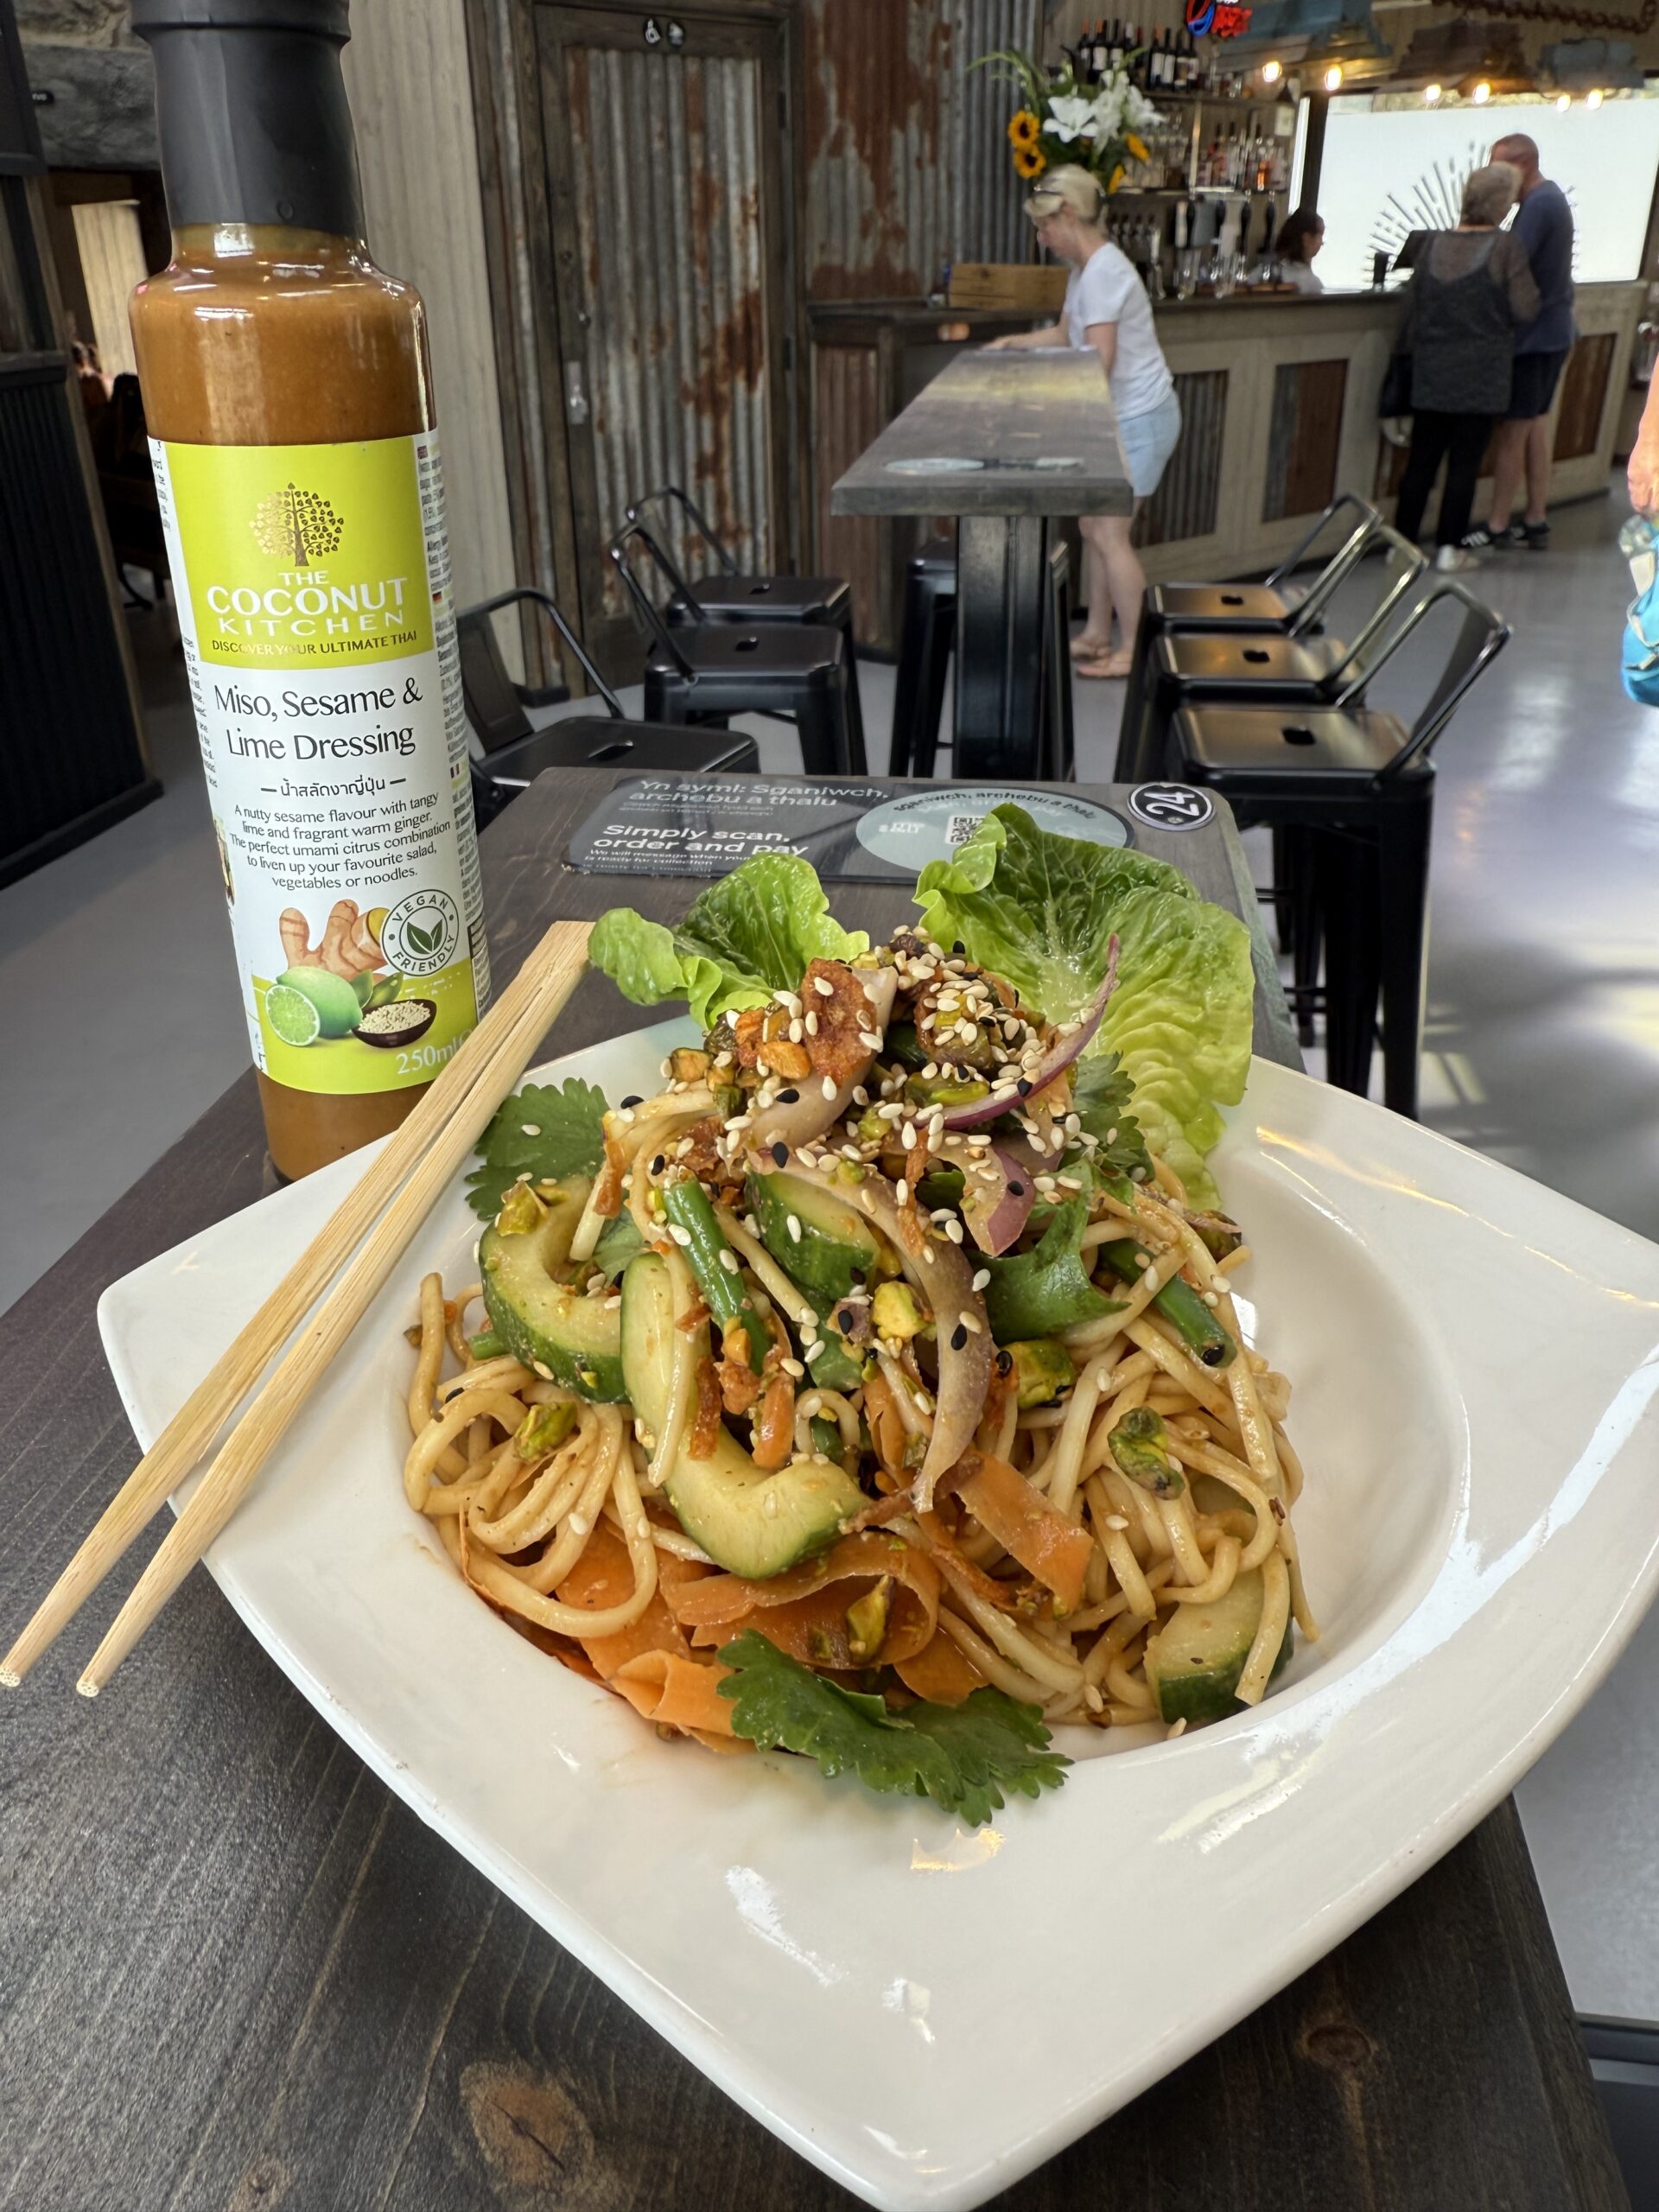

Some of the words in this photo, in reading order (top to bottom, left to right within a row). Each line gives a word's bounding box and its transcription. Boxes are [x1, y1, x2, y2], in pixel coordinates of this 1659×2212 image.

[279, 570, 329, 586] THE
[207, 577, 408, 616] COCONUT
[219, 610, 403, 637] KITCHEN
[320, 636, 389, 654] ULTIMATE
[391, 630, 417, 645] THAI
[214, 684, 278, 722] Miso,
[282, 687, 397, 717] Sesame
[402, 677, 423, 705] &
[226, 728, 286, 760] Lime
[293, 724, 416, 760] Dressing
[234, 804, 243, 817] A
[244, 808, 271, 823] nutty
[274, 811, 325, 823] sesame
[328, 808, 377, 822] flavour
[379, 799, 407, 816] with
[410, 791, 439, 810] tangy
[629, 790, 741, 804] archebu
[769, 794, 838, 806] thalu
[1142, 790, 1201, 817] 24
[229, 832, 247, 849] The
[248, 841, 290, 855] perfect
[292, 842, 340, 856] umami
[342, 841, 380, 855] citrus
[384, 821, 451, 849] combination
[242, 820, 265, 836] lime
[267, 826, 290, 839] and
[292, 827, 350, 842] fragrant
[352, 822, 391, 836] warm
[394, 811, 432, 833] ginger.
[602, 824, 709, 841] Simply
[711, 830, 791, 842] scan,
[247, 855, 257, 867] to
[259, 855, 286, 871] liven
[289, 863, 305, 875] up
[308, 862, 340, 876] your
[344, 852, 404, 872] favourite
[406, 841, 437, 861] salad,
[593, 836, 680, 851] order
[684, 841, 752, 853] and
[751, 843, 810, 857] pay
[271, 876, 341, 891] vegetables
[345, 877, 361, 887] or
[364, 867, 418, 886] noodles.
[391, 893, 448, 923] VEGAN
[391, 934, 454, 973] FRIENDLY
